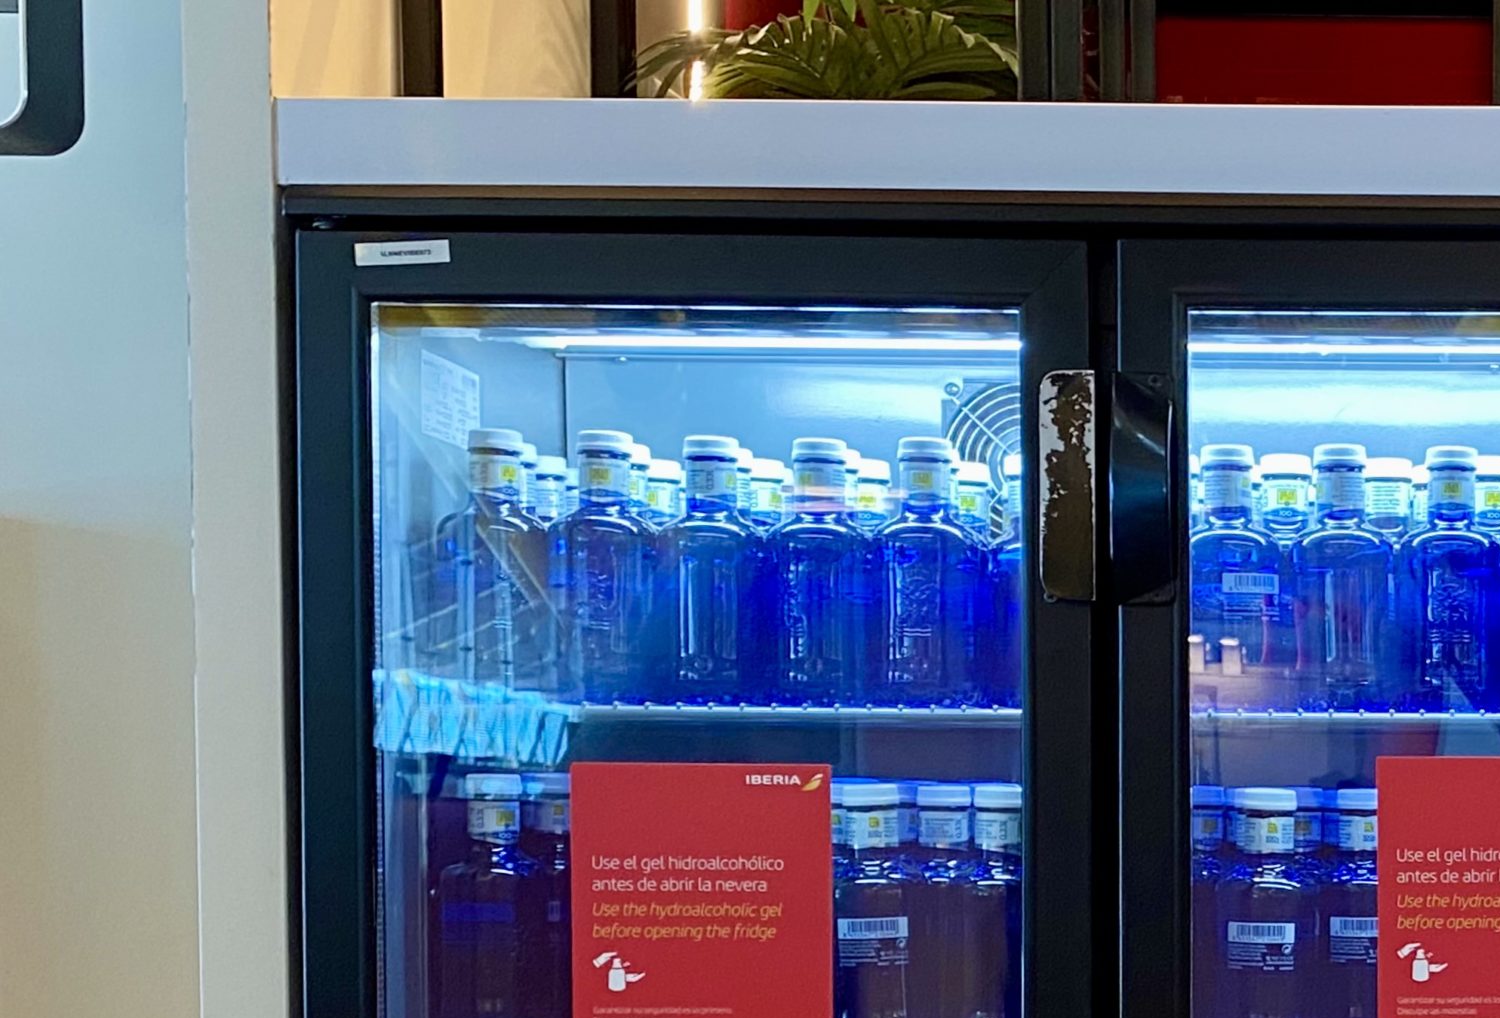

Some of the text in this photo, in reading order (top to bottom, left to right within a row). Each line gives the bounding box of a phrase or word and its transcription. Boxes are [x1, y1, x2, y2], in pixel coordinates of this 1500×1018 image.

[746, 774, 802, 785] IBERIA
[592, 855, 785, 874] Use el gel hidroalcohólico
[1396, 848, 1424, 863] Use
[1427, 848, 1441, 863] el
[1444, 848, 1467, 866] gel
[592, 877, 768, 892] antes de abrir la nevera
[1396, 871, 1437, 884] antes
[1440, 869, 1459, 884] de
[1462, 869, 1496, 884] abrir
[1397, 894, 1423, 908] Use
[1426, 894, 1450, 908] the
[592, 903, 783, 921] Use the hydroalcoholic gel
[1397, 914, 1444, 931] before
[592, 923, 777, 942] before opening the fridge
